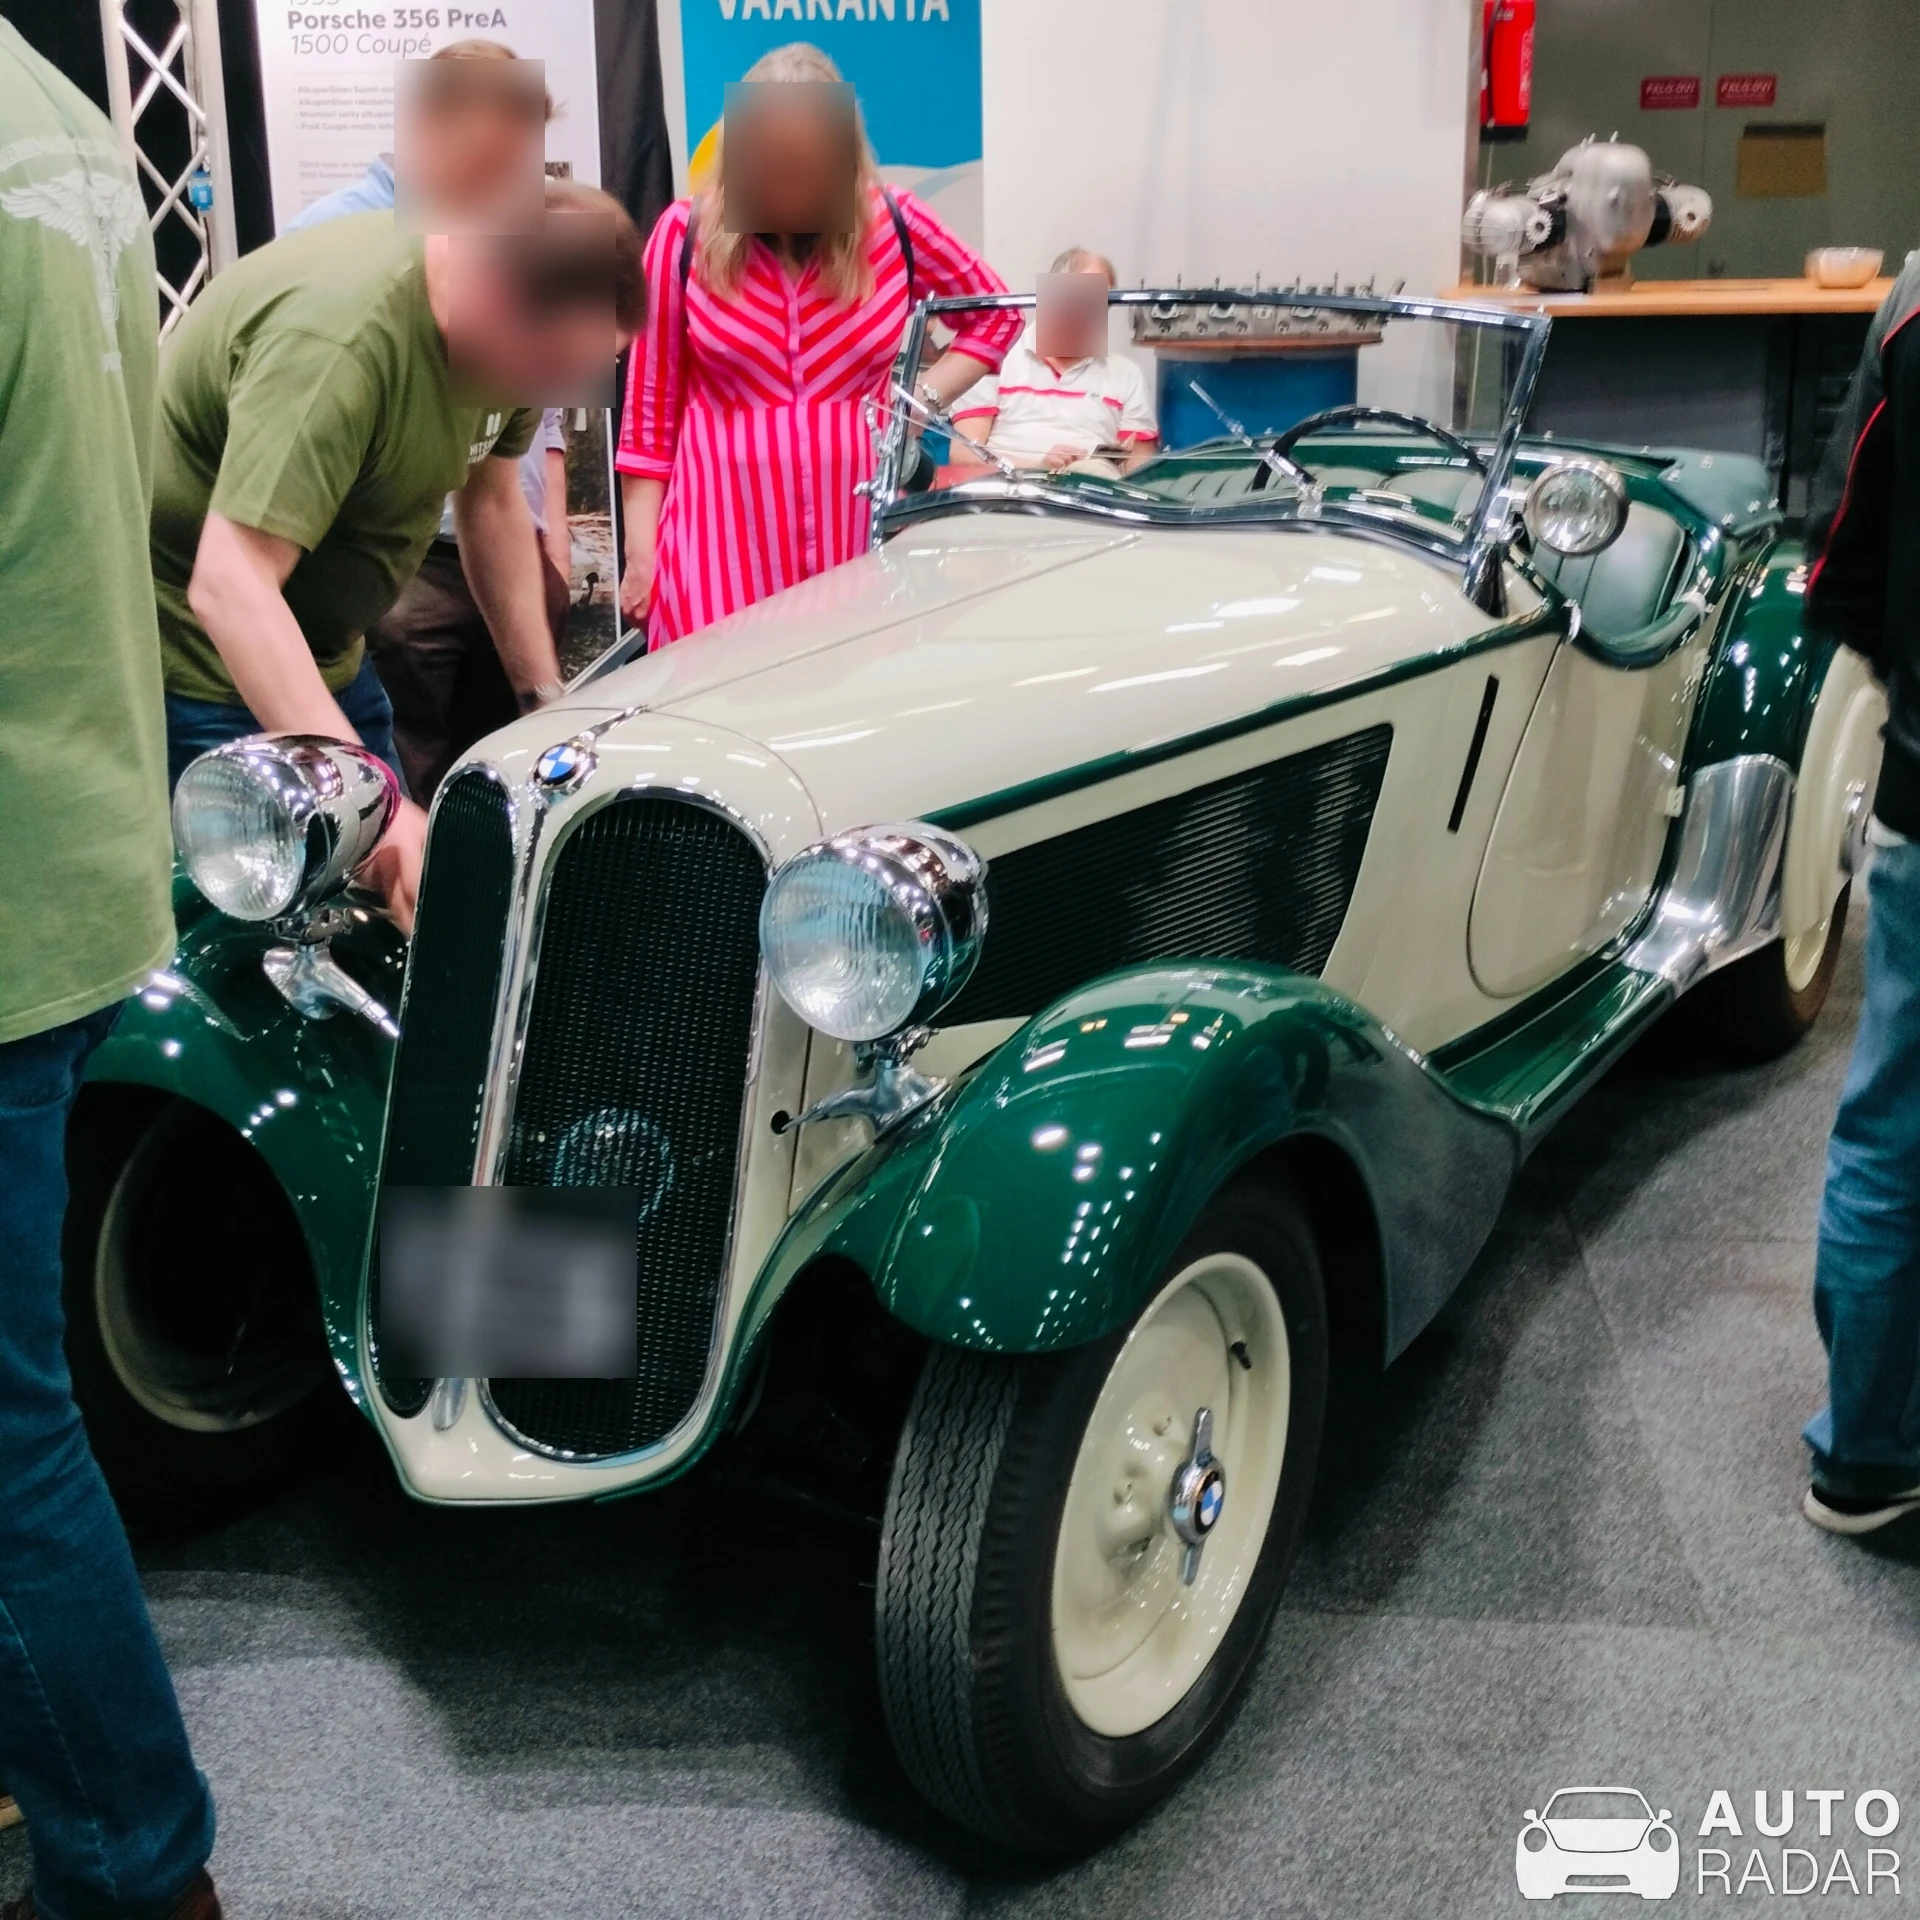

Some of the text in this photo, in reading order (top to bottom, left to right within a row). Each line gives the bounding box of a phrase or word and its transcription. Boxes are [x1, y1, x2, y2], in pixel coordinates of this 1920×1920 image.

[287, 8, 507, 30] Porsche 356 PreA
[291, 32, 432, 59] 1500 Coupé
